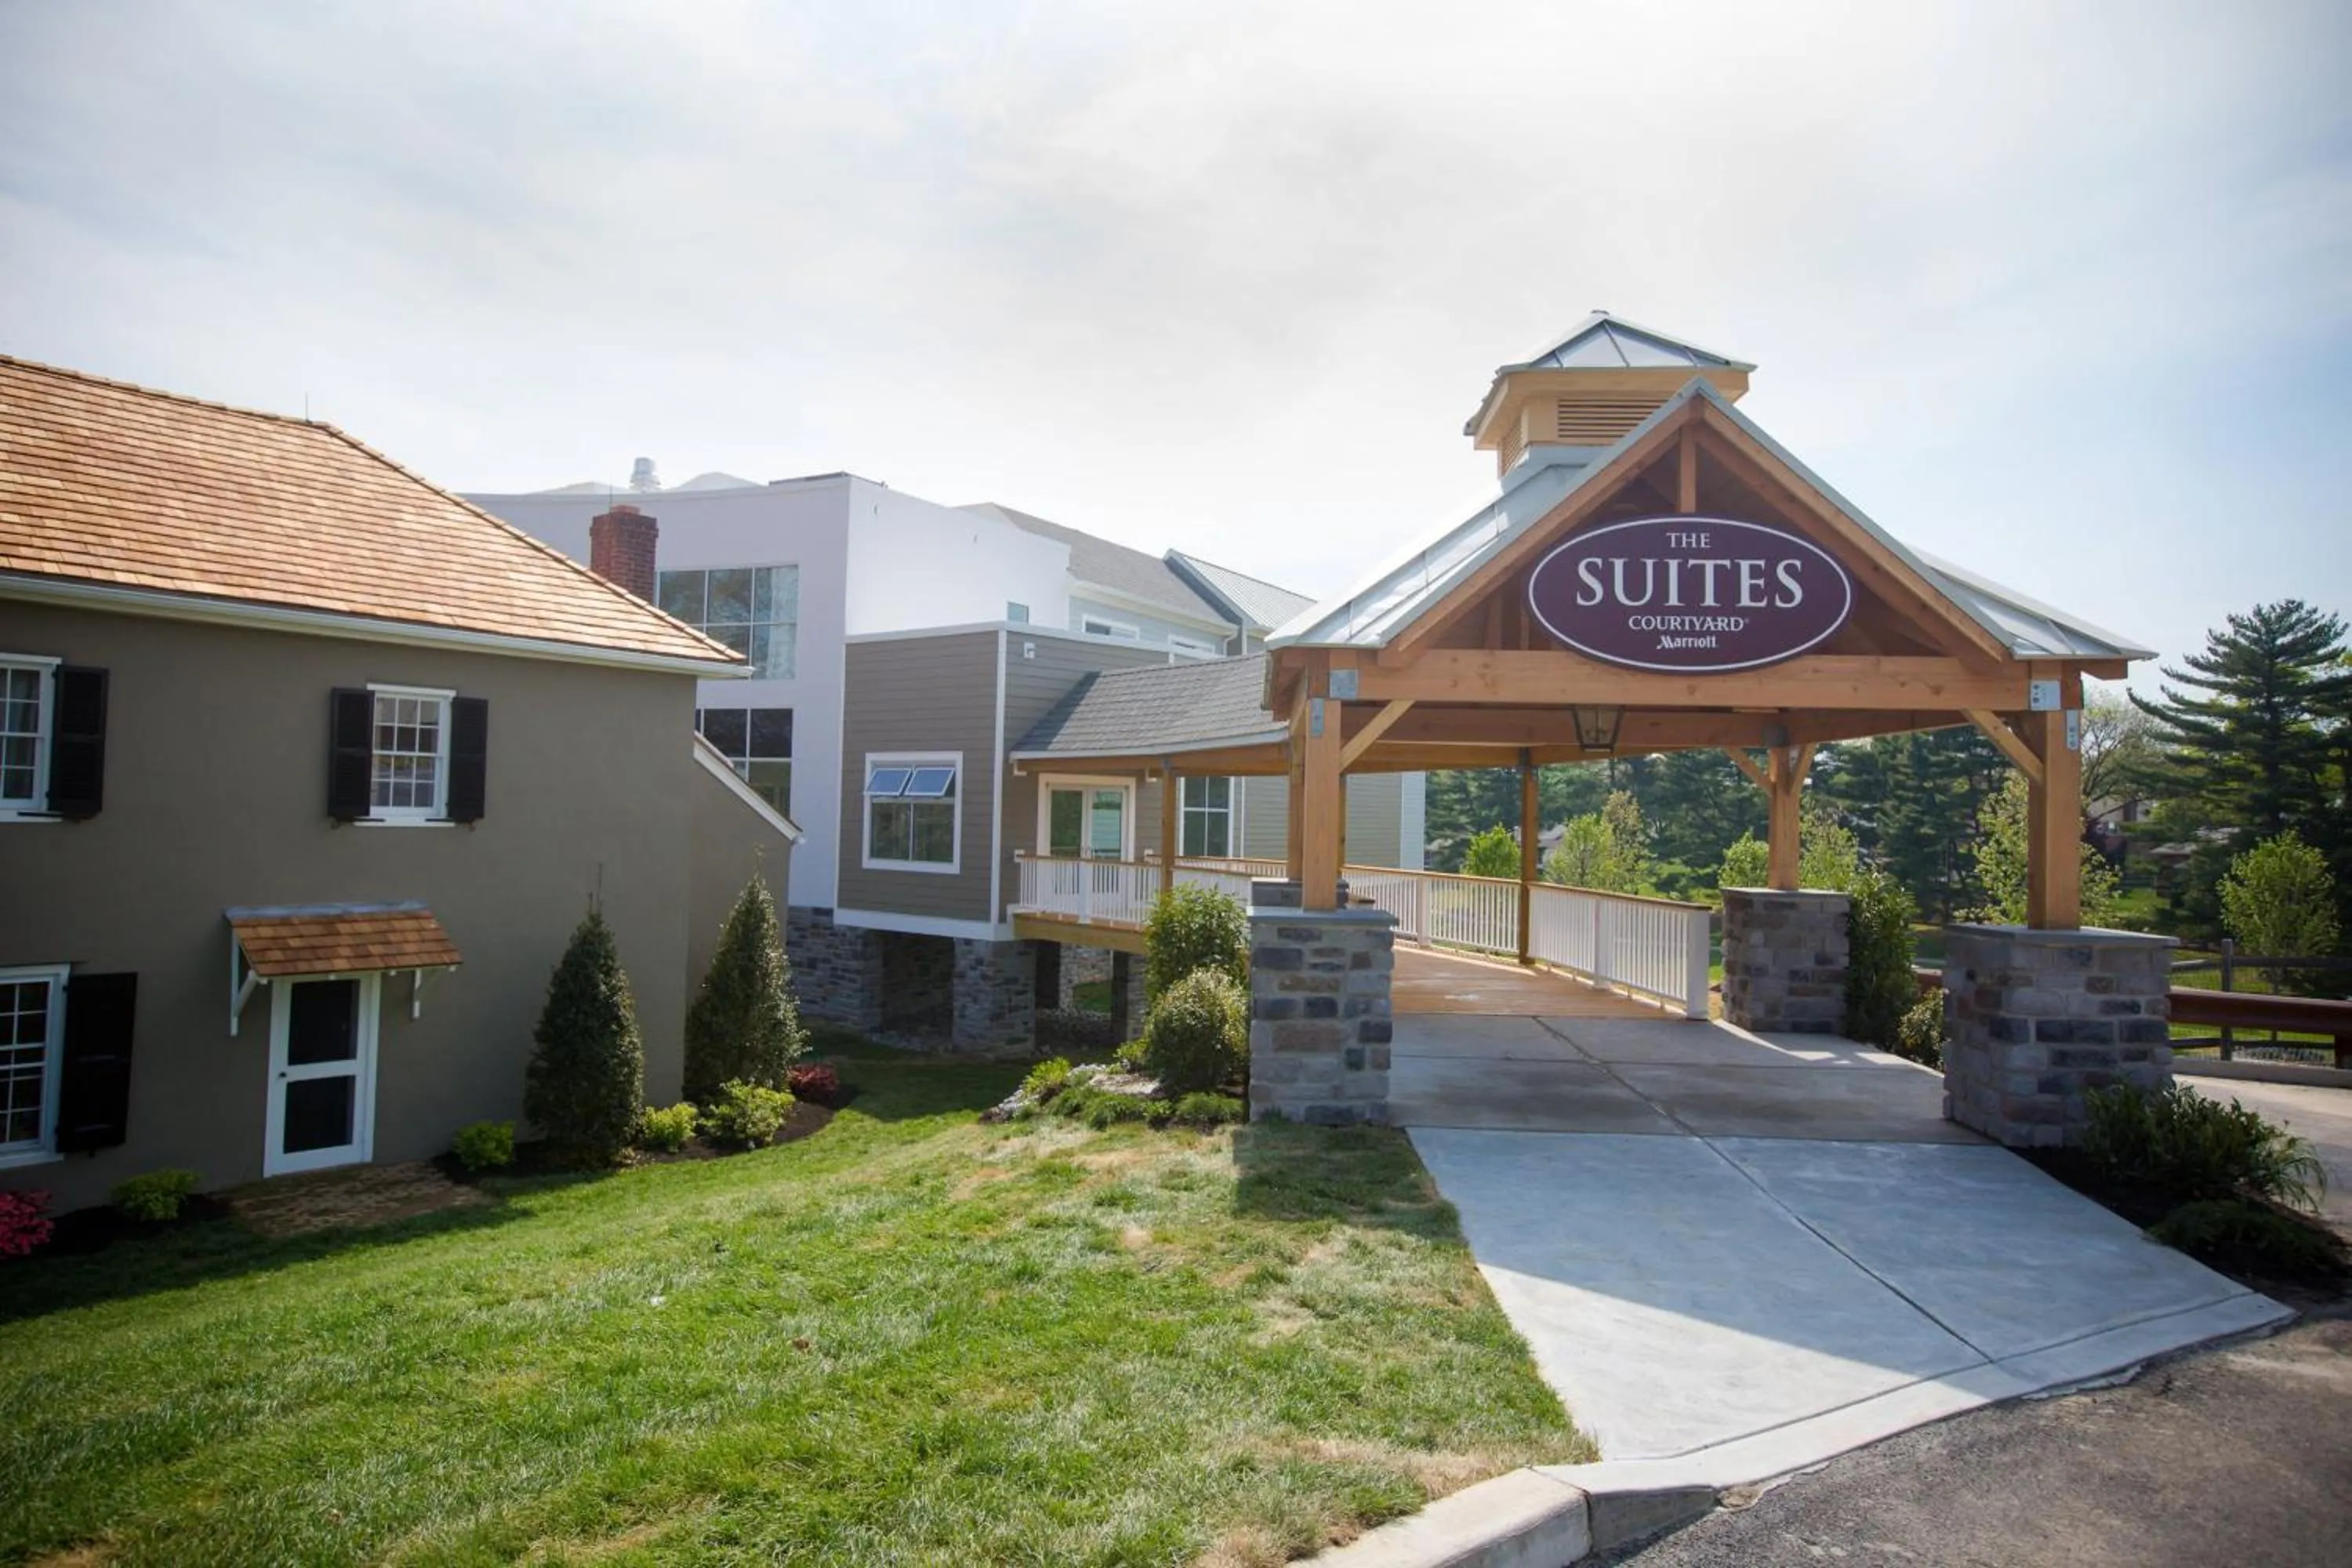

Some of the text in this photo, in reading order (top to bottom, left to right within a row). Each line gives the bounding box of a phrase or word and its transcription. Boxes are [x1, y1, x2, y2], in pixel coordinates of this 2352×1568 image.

[1666, 532, 1711, 548] THE
[1576, 557, 1803, 608] SUITES
[1628, 615, 1744, 631] COURTYARD
[1656, 635, 1717, 649] Marriott
